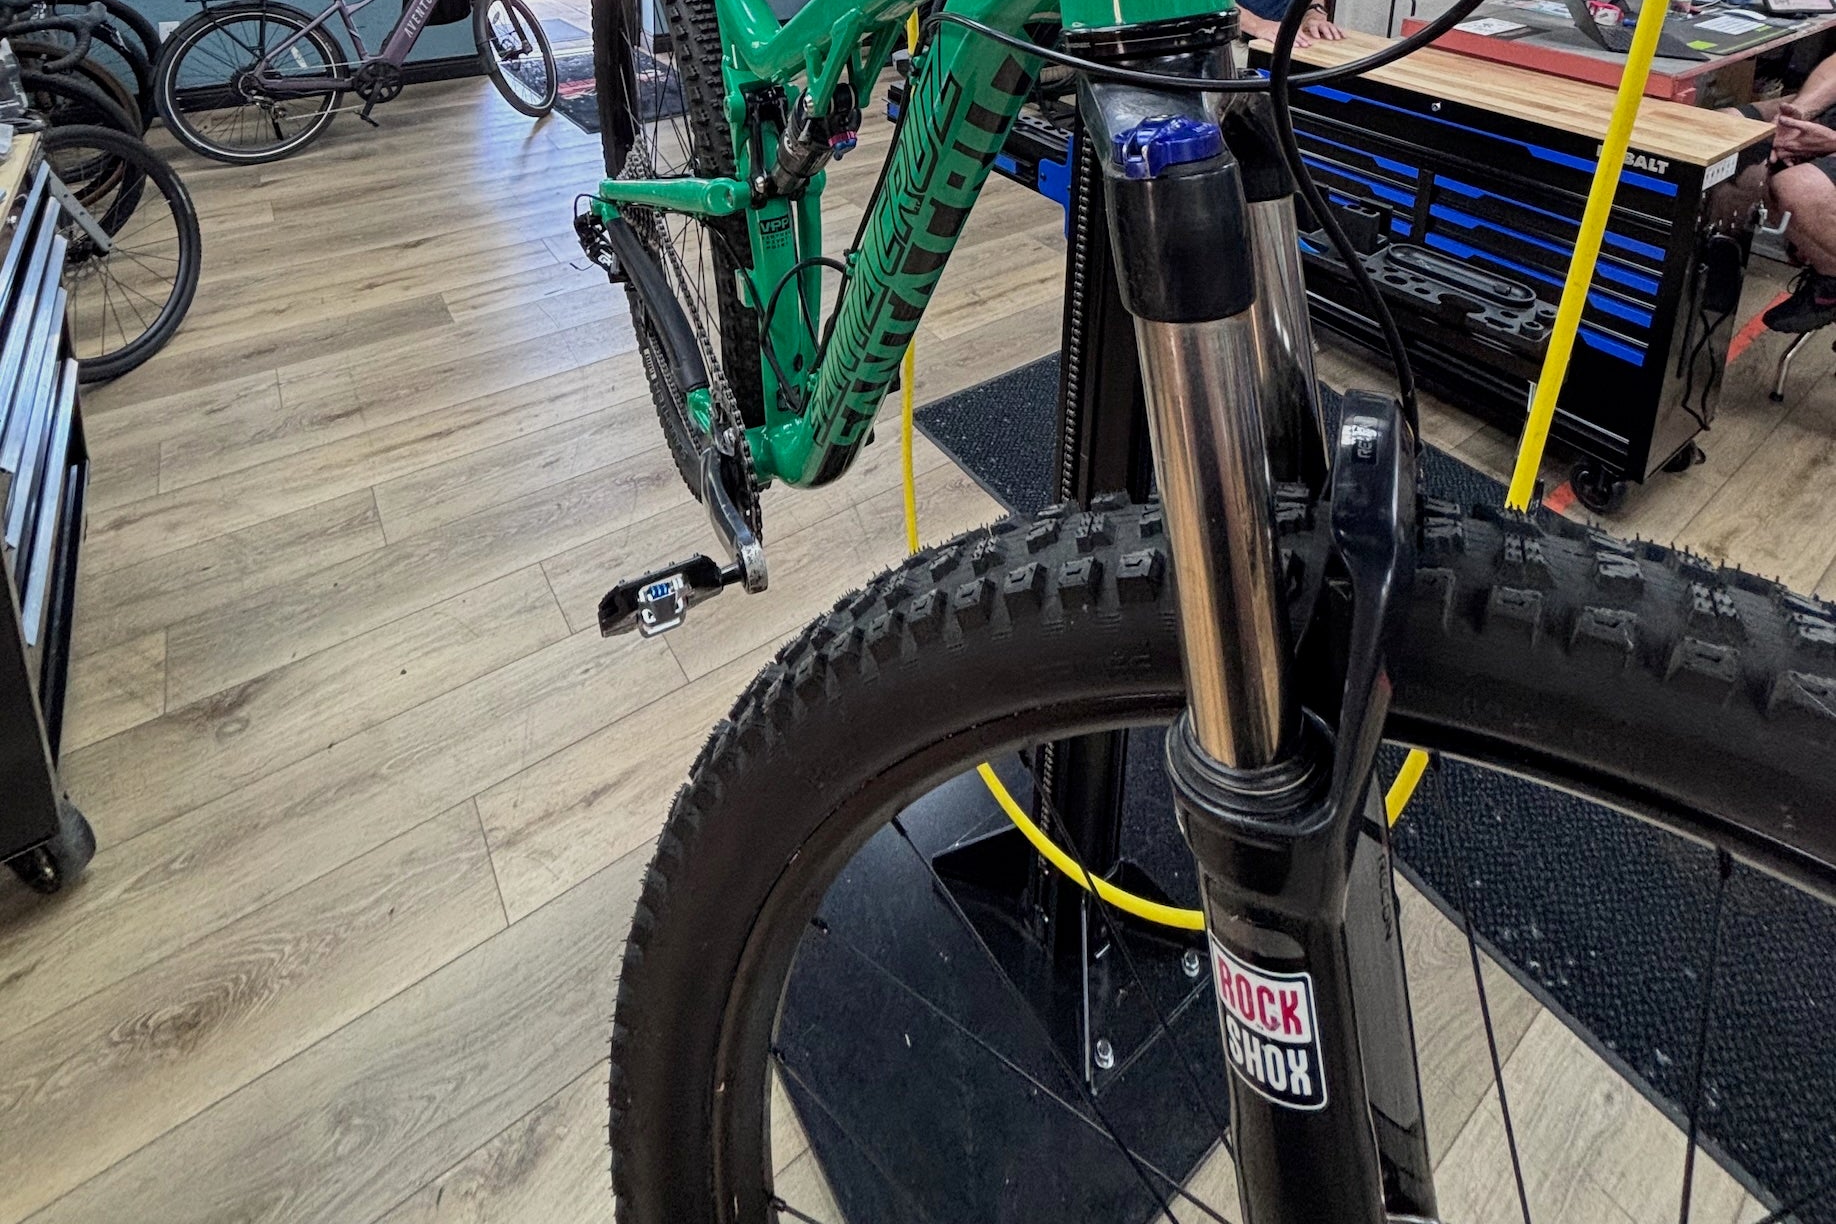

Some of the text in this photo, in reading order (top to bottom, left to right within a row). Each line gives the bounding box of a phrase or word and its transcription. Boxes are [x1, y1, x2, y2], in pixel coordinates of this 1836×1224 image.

[1596, 144, 1669, 175] BALT
[760, 216, 789, 233] VPP
[1217, 955, 1303, 1035] ROCK
[1225, 1014, 1313, 1096] SHOX
